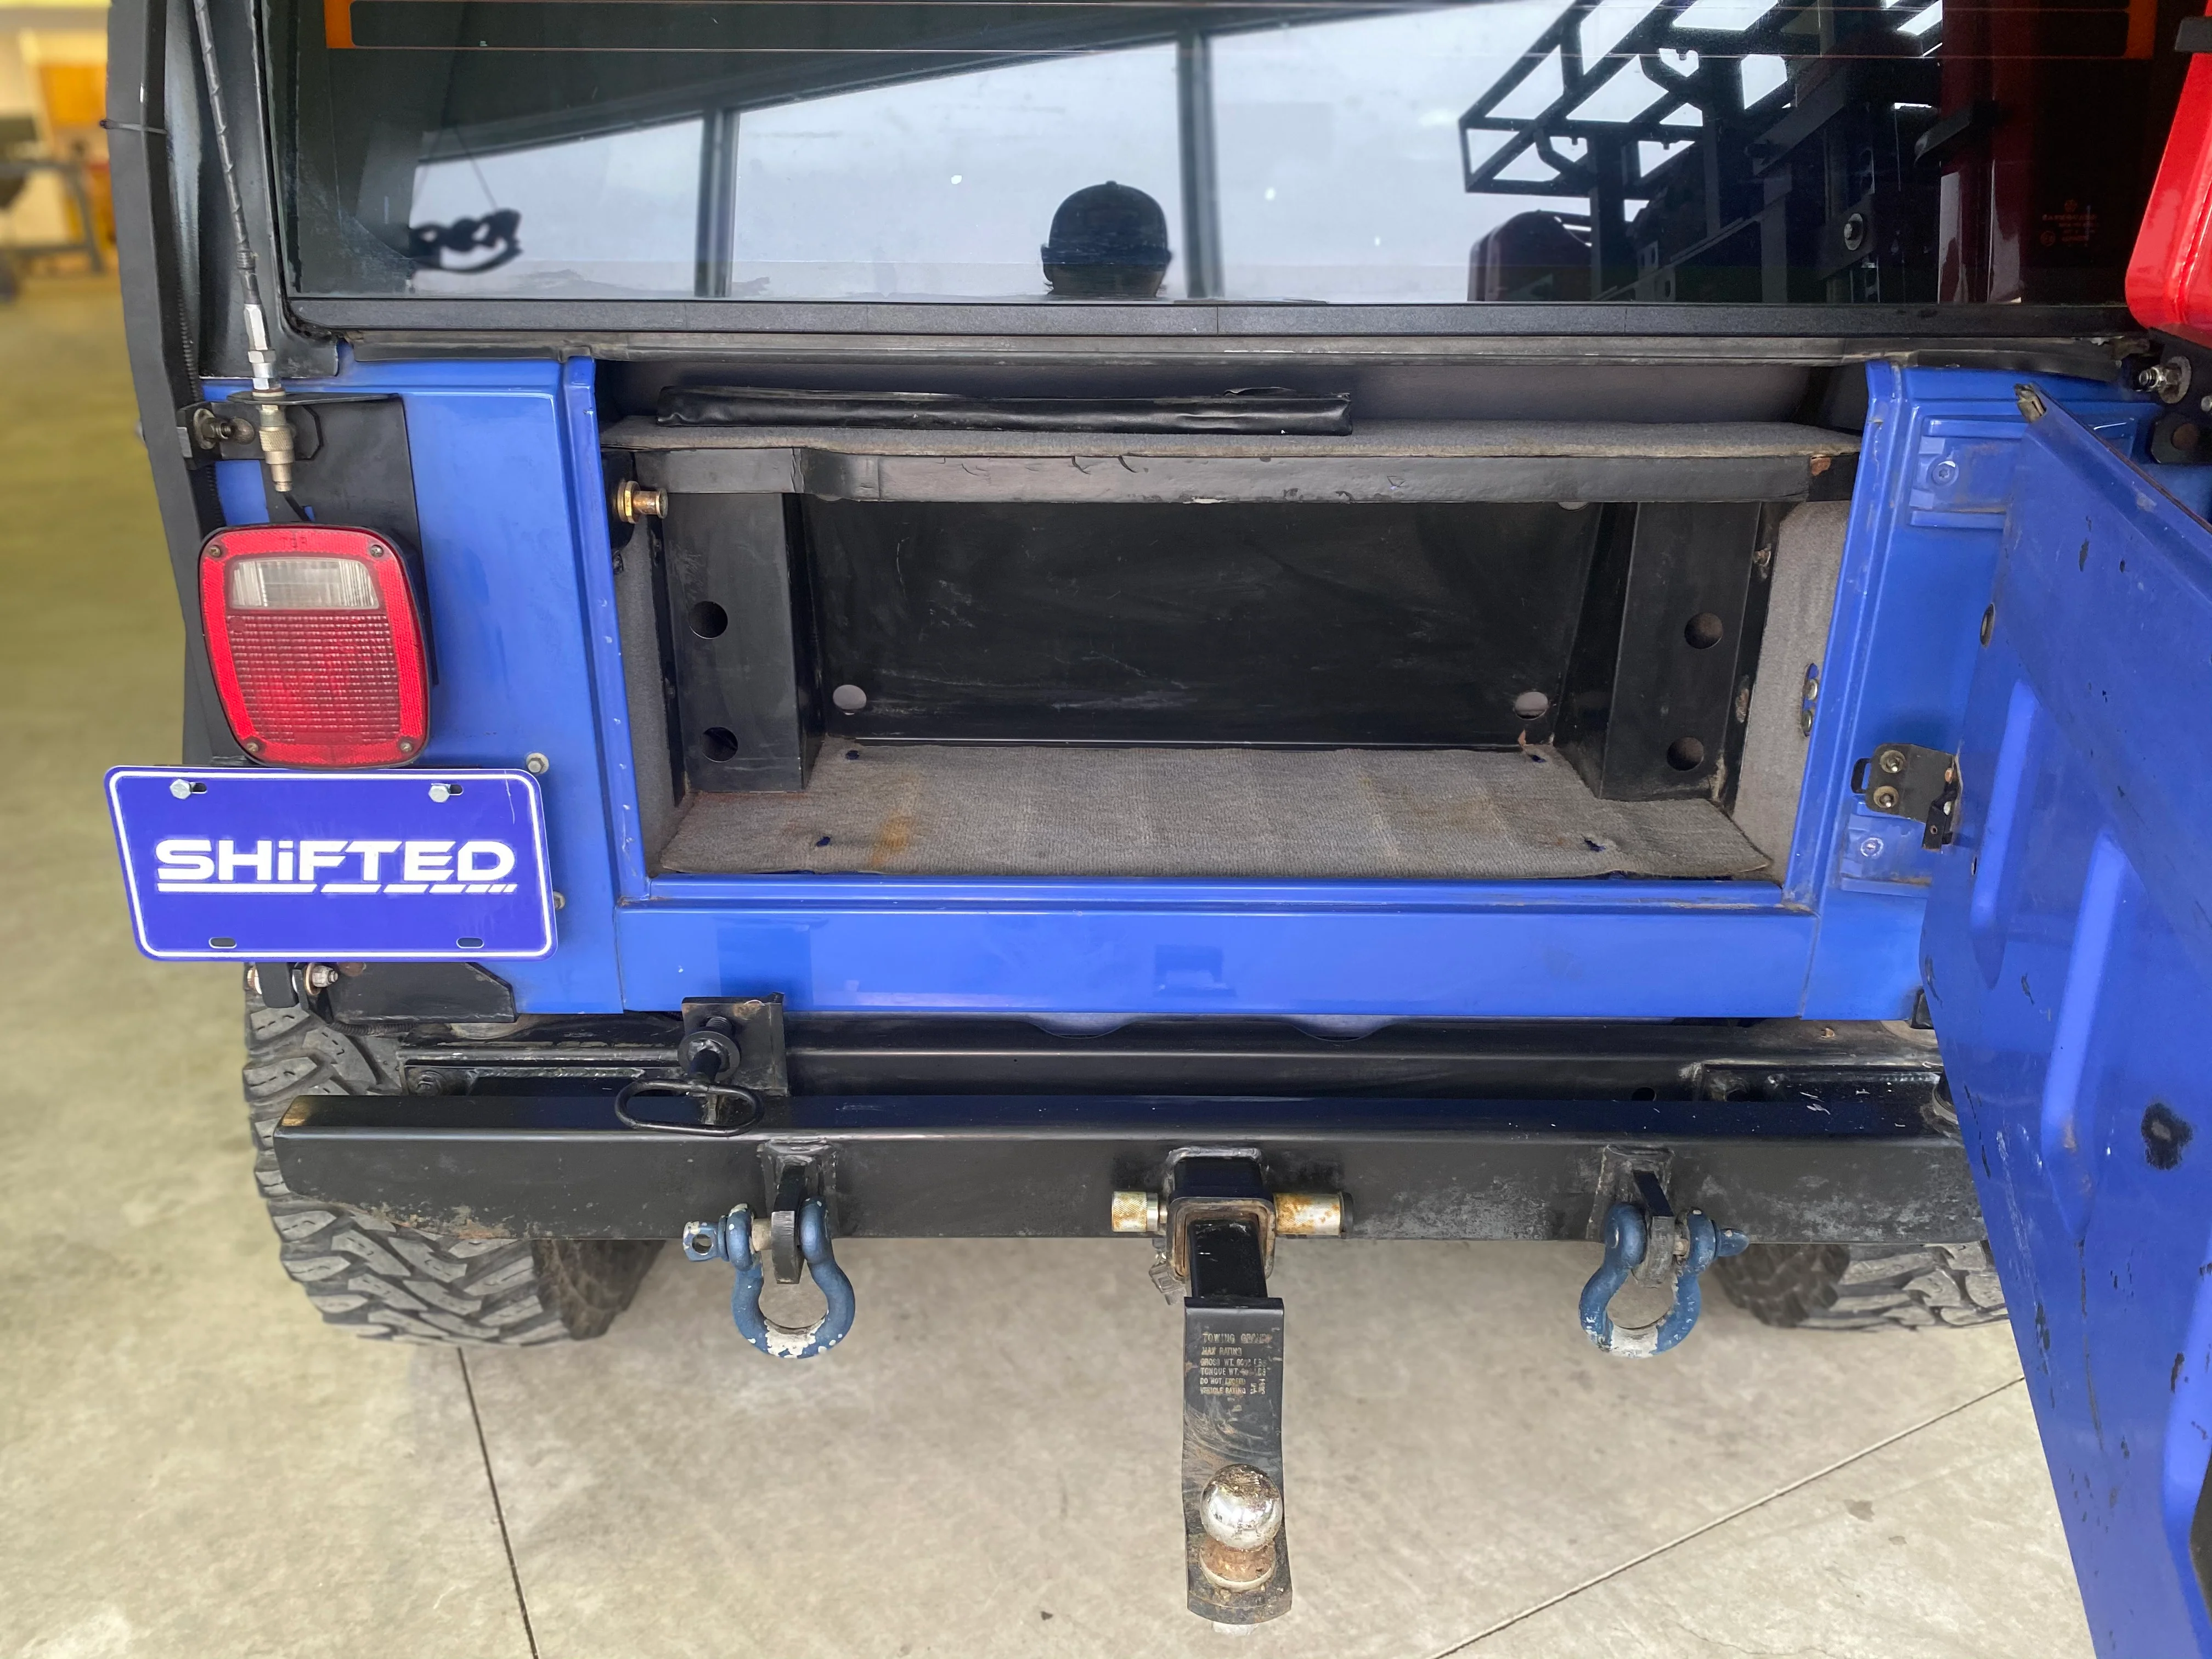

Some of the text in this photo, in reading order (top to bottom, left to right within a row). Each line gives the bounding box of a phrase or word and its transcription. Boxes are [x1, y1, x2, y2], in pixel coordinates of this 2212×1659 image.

[1203, 1333, 1235, 1344] TOWING
[1201, 1347, 1242, 1356] MAX RATING
[1200, 1358, 1220, 1366] GROSS
[1200, 1367, 1226, 1375] TONGUE
